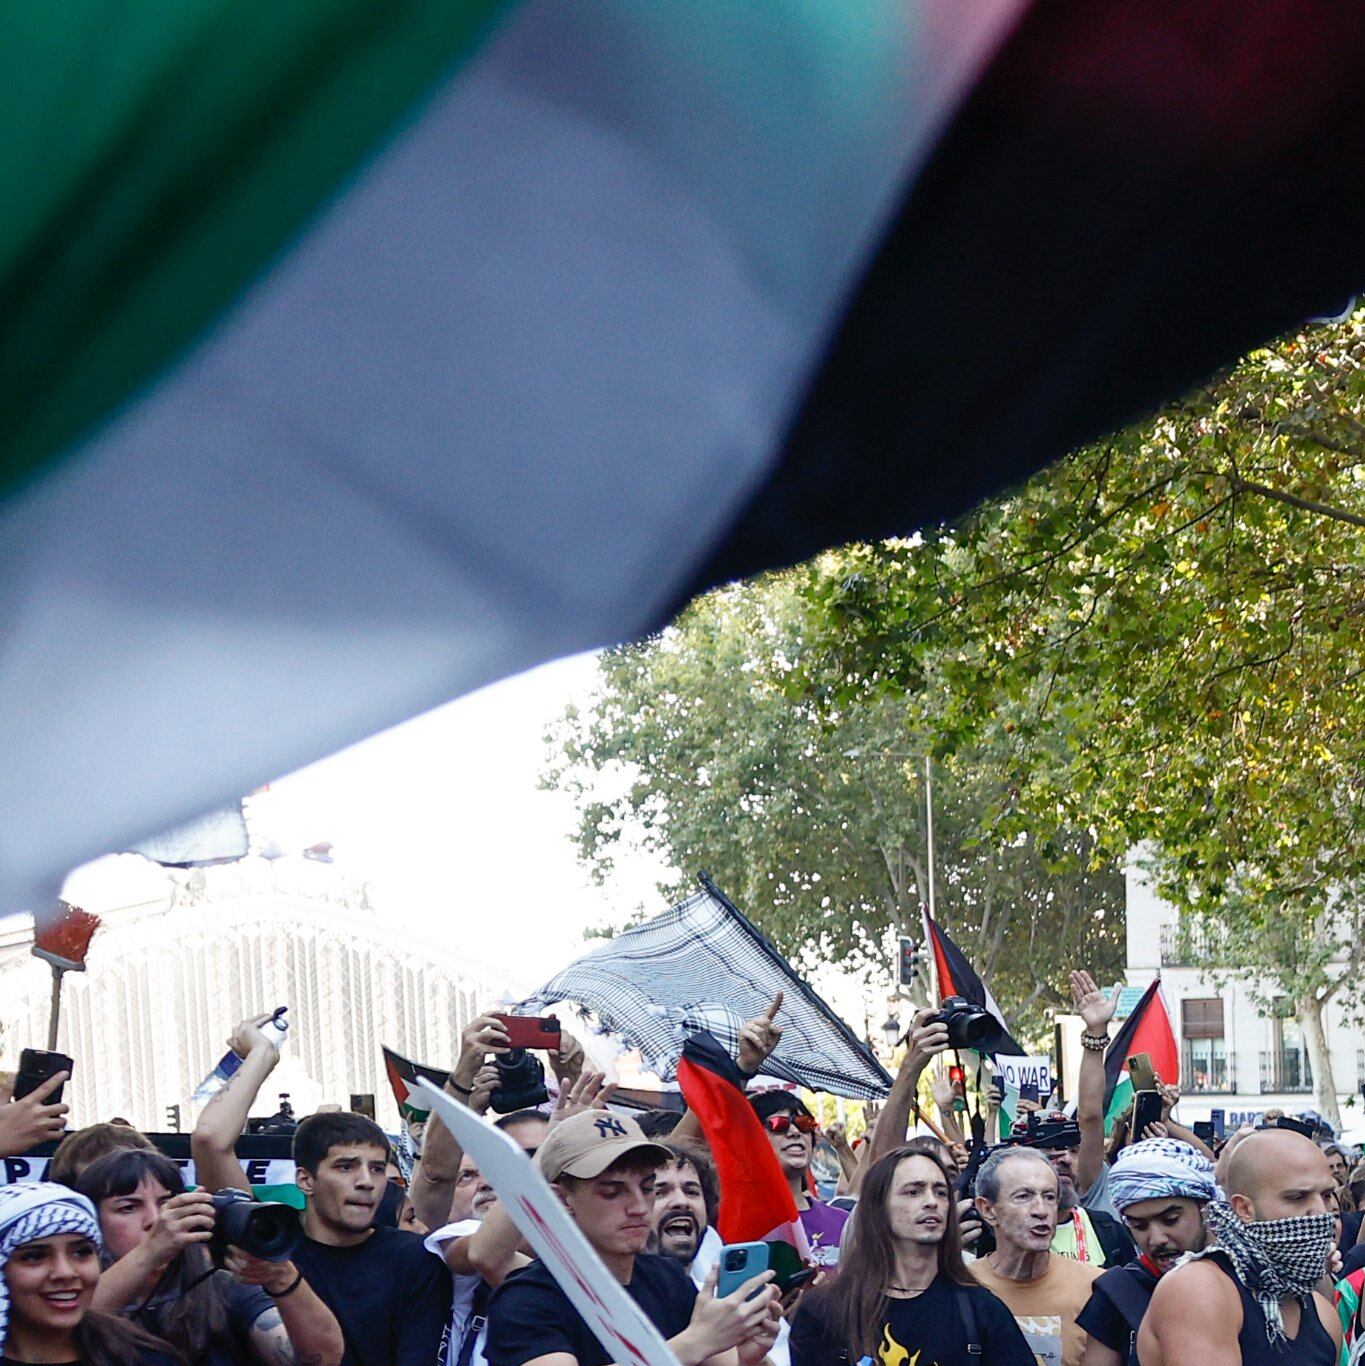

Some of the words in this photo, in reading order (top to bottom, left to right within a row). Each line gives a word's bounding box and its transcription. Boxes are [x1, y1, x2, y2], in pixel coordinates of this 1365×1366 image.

[999, 1063, 1015, 1083] NO
[1018, 1066, 1048, 1088] WAR
[594, 1117, 628, 1138] NY
